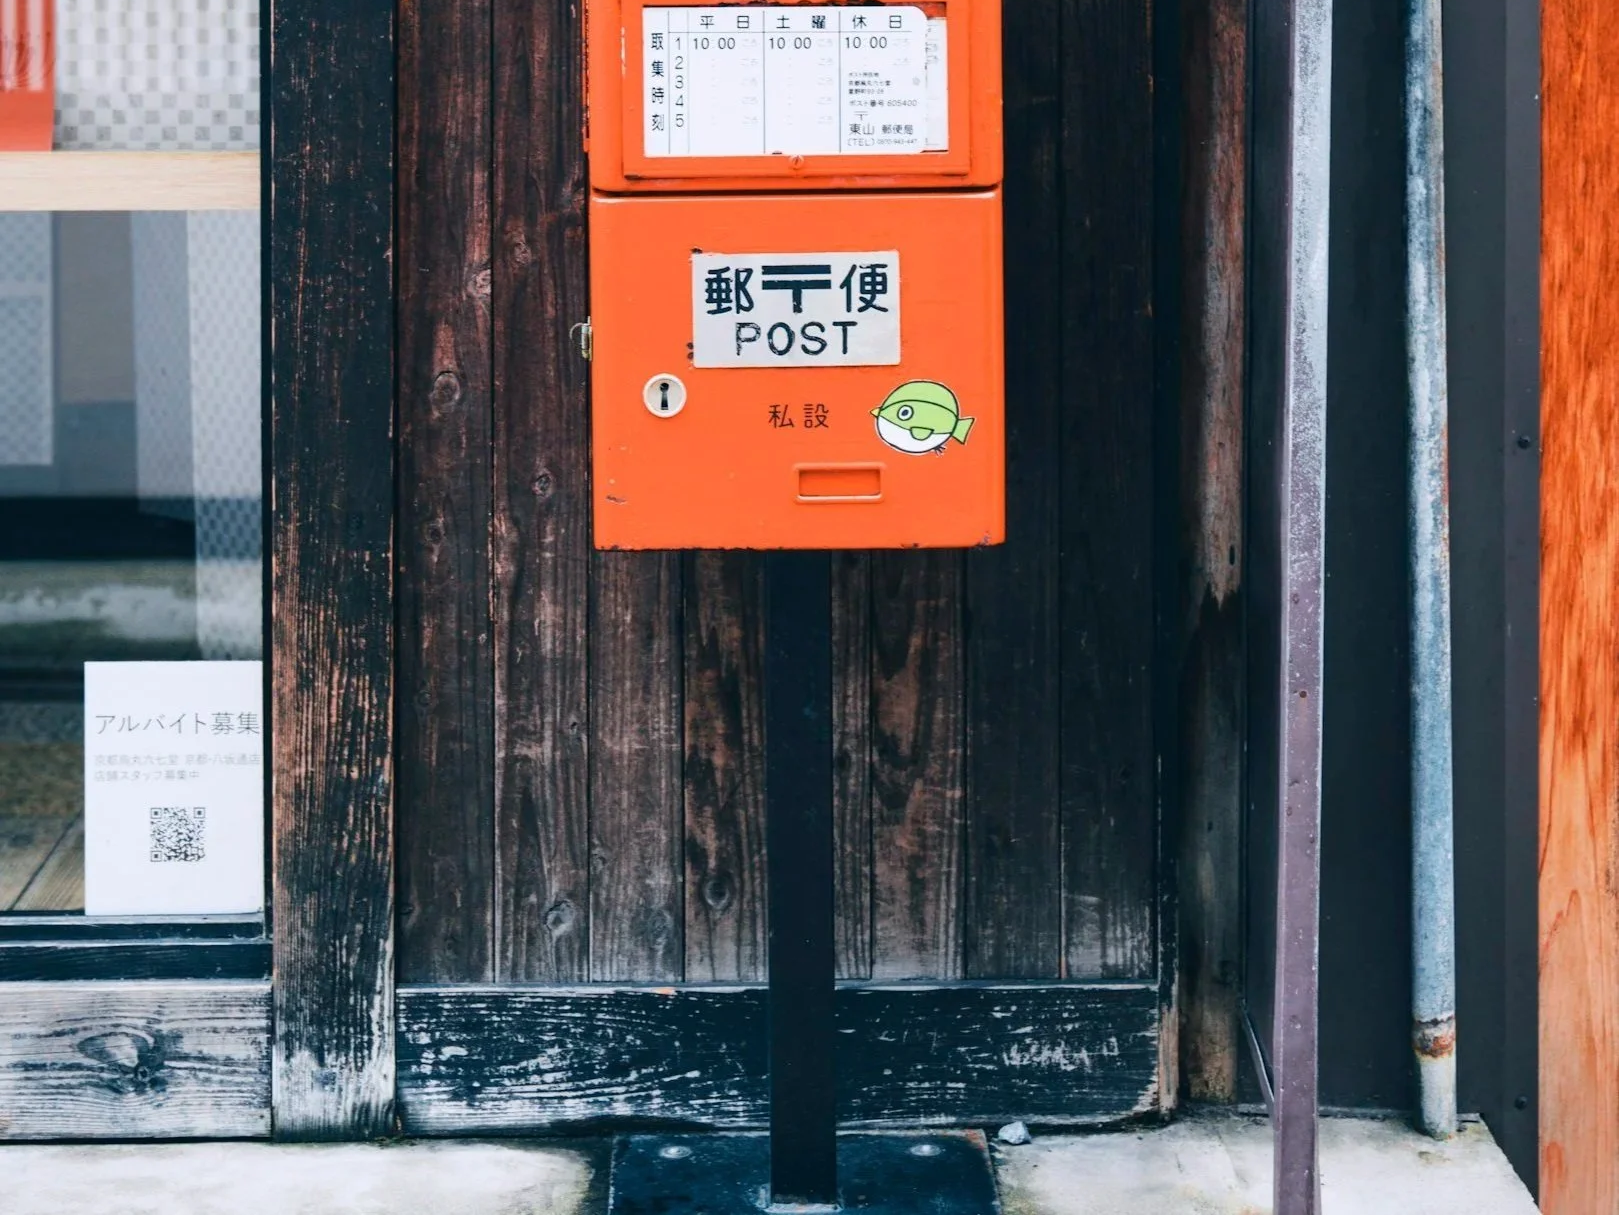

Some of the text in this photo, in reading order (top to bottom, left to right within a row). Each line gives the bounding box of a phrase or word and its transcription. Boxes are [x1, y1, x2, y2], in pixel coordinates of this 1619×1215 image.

[700, 15, 750, 30] 平日
[776, 15, 827, 30] 土曜
[852, 14, 903, 29] 休日
[675, 37, 682, 51] 1
[674, 55, 684, 70] 2
[674, 75, 684, 89] 3
[674, 94, 684, 107] 4
[674, 113, 685, 128] 5
[849, 123, 875, 136] 東山
[735, 321, 858, 356] POST
[768, 403, 830, 429] 私設
[95, 712, 261, 735] アルバイト募集
